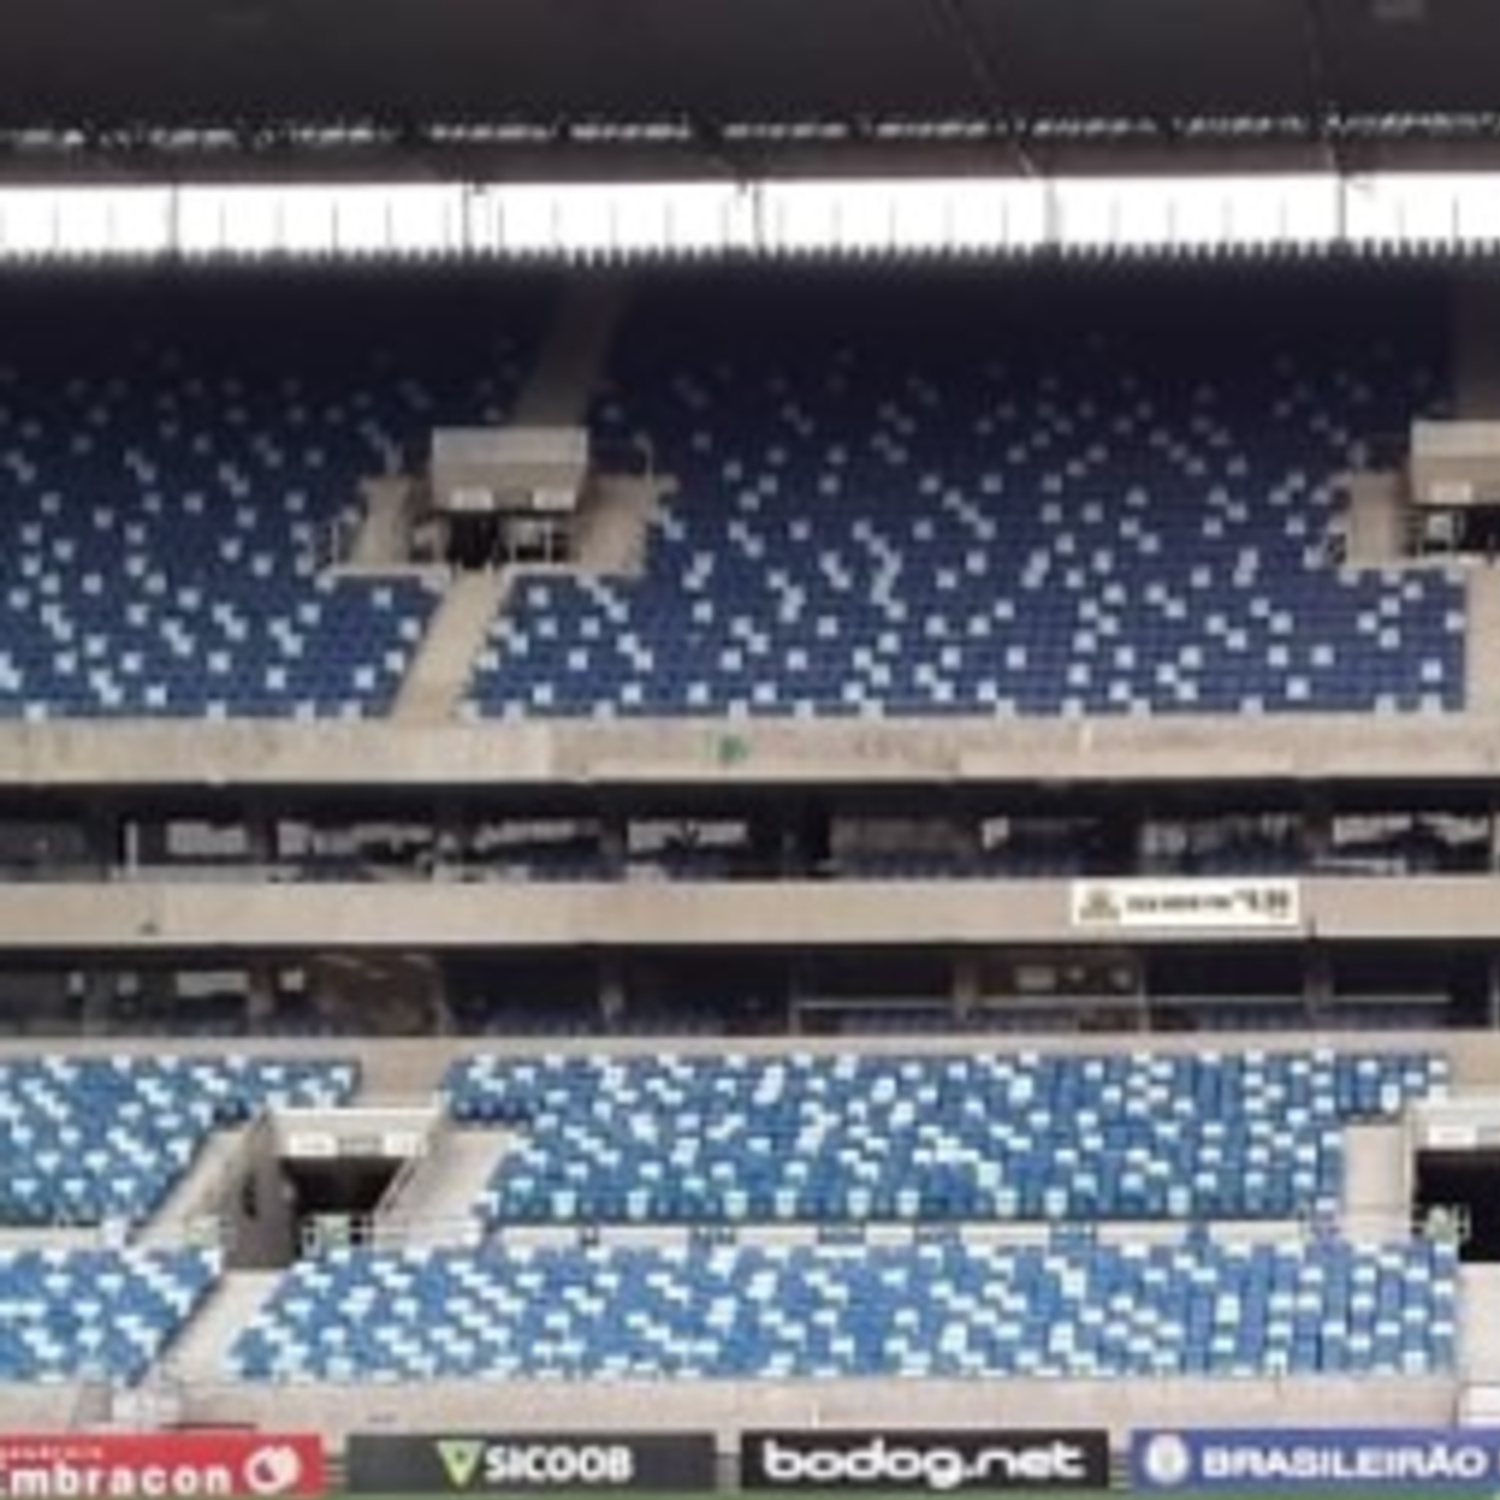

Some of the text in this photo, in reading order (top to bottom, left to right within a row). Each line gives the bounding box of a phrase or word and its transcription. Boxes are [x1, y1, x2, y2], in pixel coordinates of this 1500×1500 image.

[484, 1445, 636, 1483] SICOOB
[762, 1438, 1087, 1488] bodog.net
[1202, 1439, 1488, 1478] BRASILEIRÃO
[0, 1461, 232, 1496] mbracon
